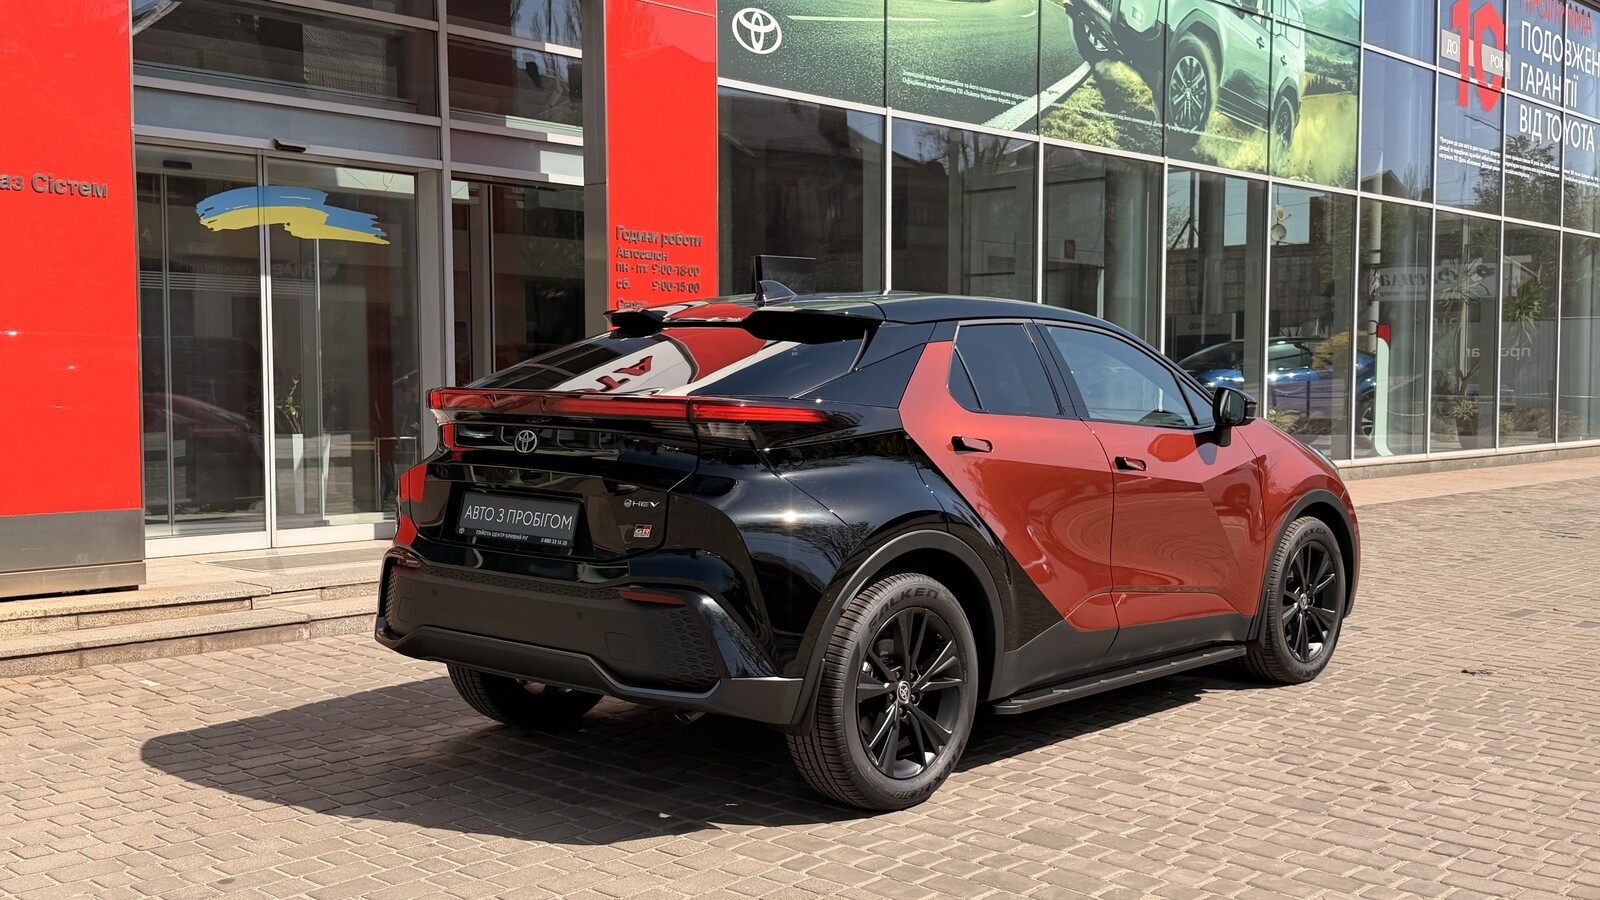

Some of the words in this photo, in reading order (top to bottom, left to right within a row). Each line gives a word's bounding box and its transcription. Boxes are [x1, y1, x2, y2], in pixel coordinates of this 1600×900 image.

[1446, 39, 1458, 55] ДО
[1452, 0, 1505, 113] 10
[1519, 104, 1542, 144] ВІД
[31, 173, 107, 198] Сістем
[616, 225, 659, 245] Години
[660, 232, 702, 248] роботи
[616, 246, 668, 261] Автосалон
[615, 277, 630, 290] сб.
[652, 279, 700, 294] 9:00-15:00
[464, 504, 495, 522] АВТО
[496, 508, 504, 523] З
[506, 509, 573, 531] ПРОБІГОМ
